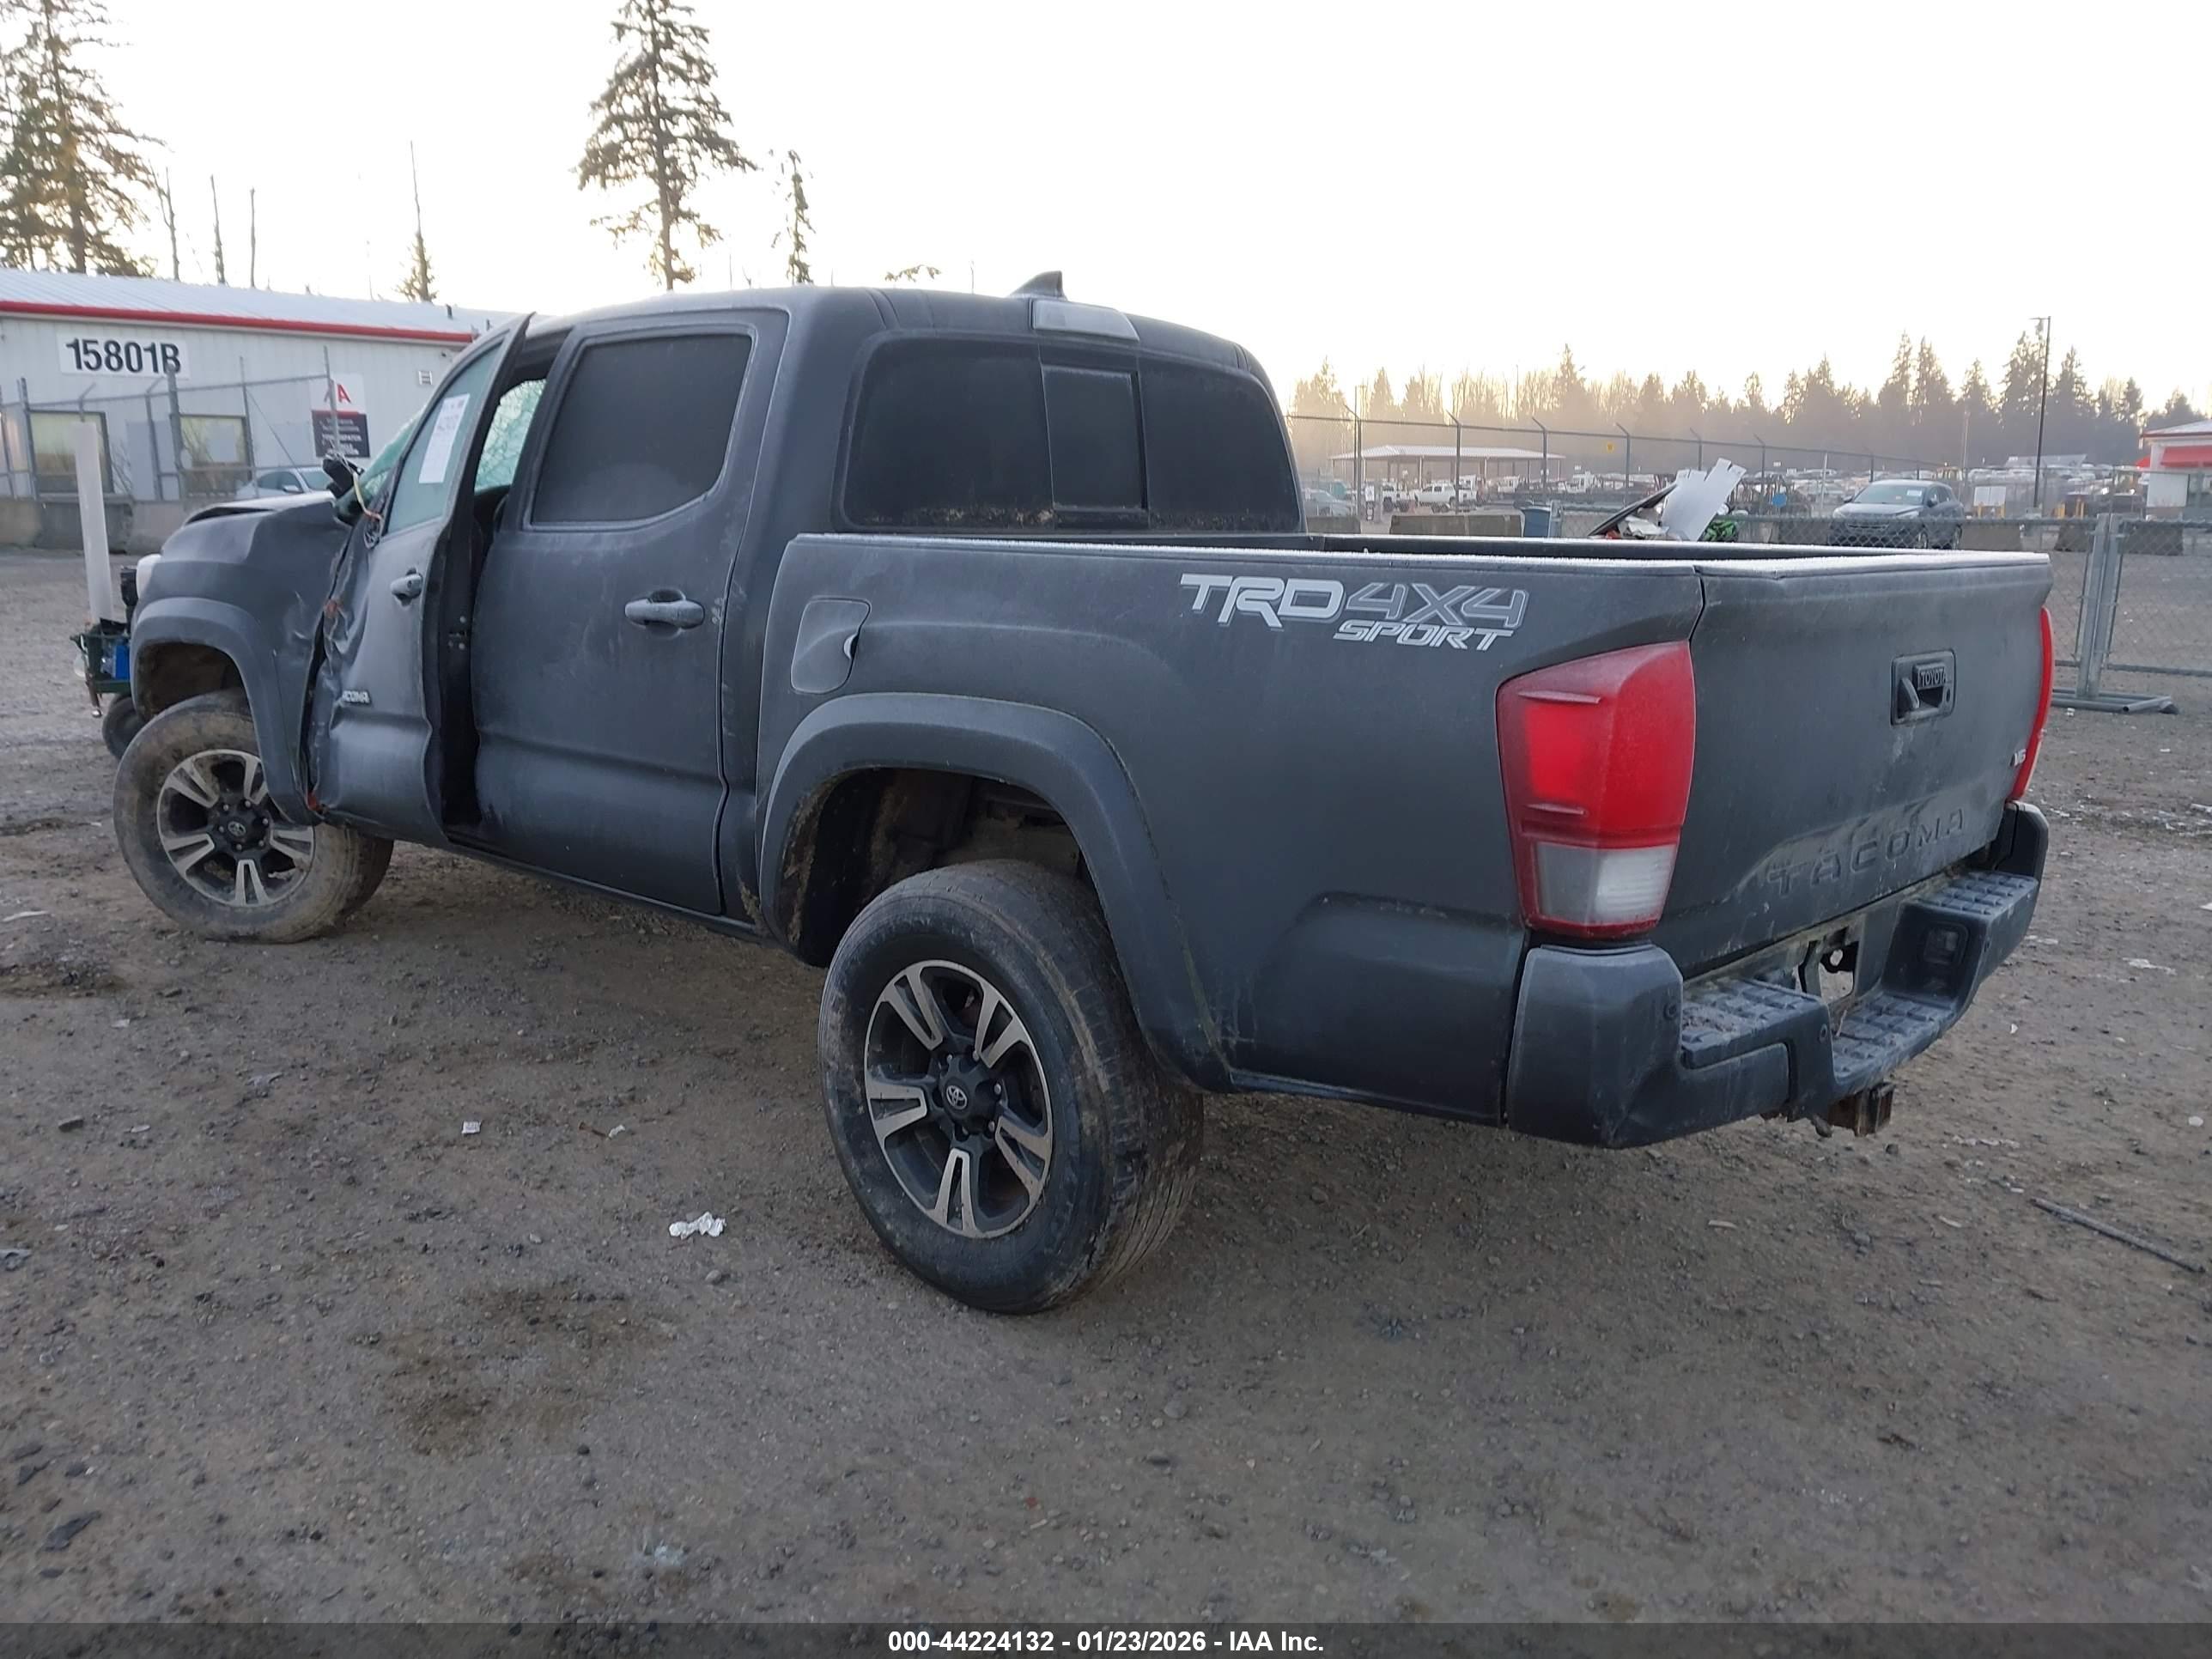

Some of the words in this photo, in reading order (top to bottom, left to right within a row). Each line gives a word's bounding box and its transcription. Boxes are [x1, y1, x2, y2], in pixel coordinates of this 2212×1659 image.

[65, 337, 181, 374] 15801B
[1180, 573, 1346, 631] TRD
[1333, 619, 1514, 651] SPORT
[1920, 668, 1948, 688] TOYOTA
[1766, 808, 1964, 896] TACOMA
